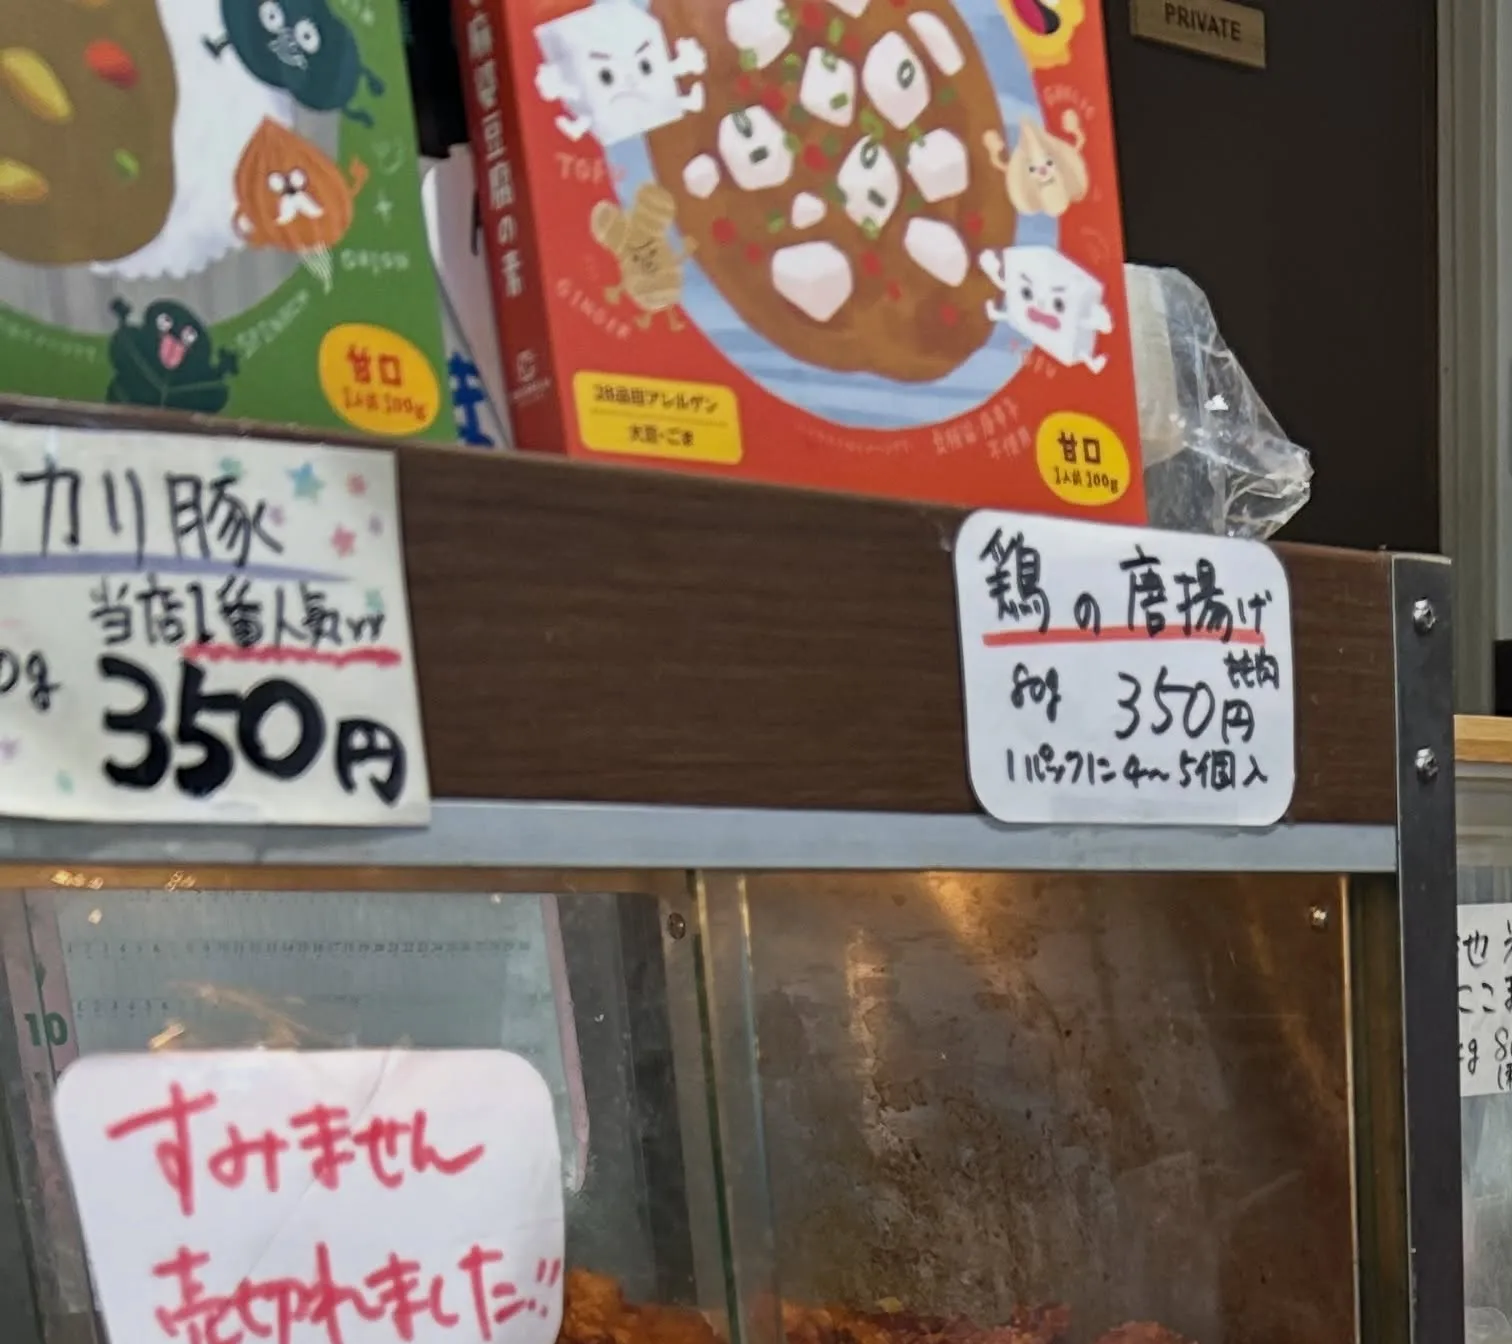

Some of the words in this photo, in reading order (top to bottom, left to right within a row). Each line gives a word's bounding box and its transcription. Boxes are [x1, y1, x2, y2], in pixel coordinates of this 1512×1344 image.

[1163, 2, 1242, 41] PRIVATE
[346, 344, 404, 387] 甘口
[1056, 429, 1103, 467] 甘口
[980, 527, 1273, 644] 鶏の唐揚げ
[98, 655, 407, 806] 350円
[1113, 665, 1256, 744] 350円
[24, 1012, 69, 1047] 10
[105, 1080, 486, 1217] すみません
